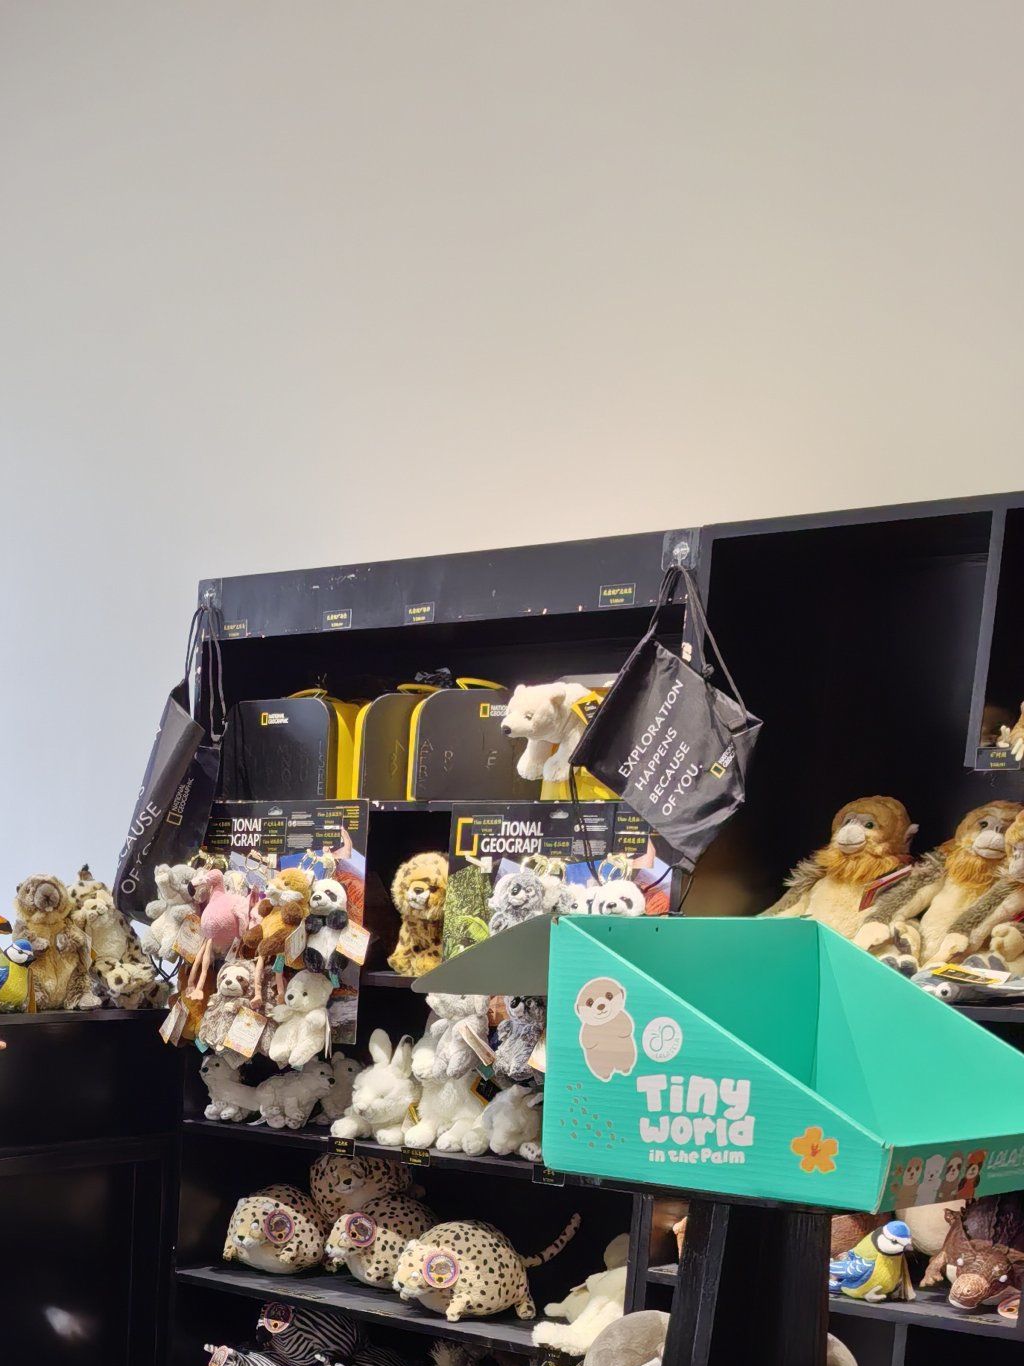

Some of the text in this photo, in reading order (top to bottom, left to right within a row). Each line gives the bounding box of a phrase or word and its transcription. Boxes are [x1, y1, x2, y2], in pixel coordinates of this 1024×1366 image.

[618, 679, 684, 778] EXPLORATION
[634, 727, 678, 791] HAPPENS
[648, 741, 691, 804] BECAUSE
[661, 763, 703, 816] OF YOU.
[117, 801, 163, 869] CAUSE
[480, 837, 543, 854] GEOGRAP
[497, 821, 544, 836] TIONAL
[121, 867, 142, 894] OF
[636, 1074, 751, 1120] Tiny
[639, 1115, 756, 1147] world
[648, 1149, 666, 1163] in
[667, 1149, 699, 1164] the
